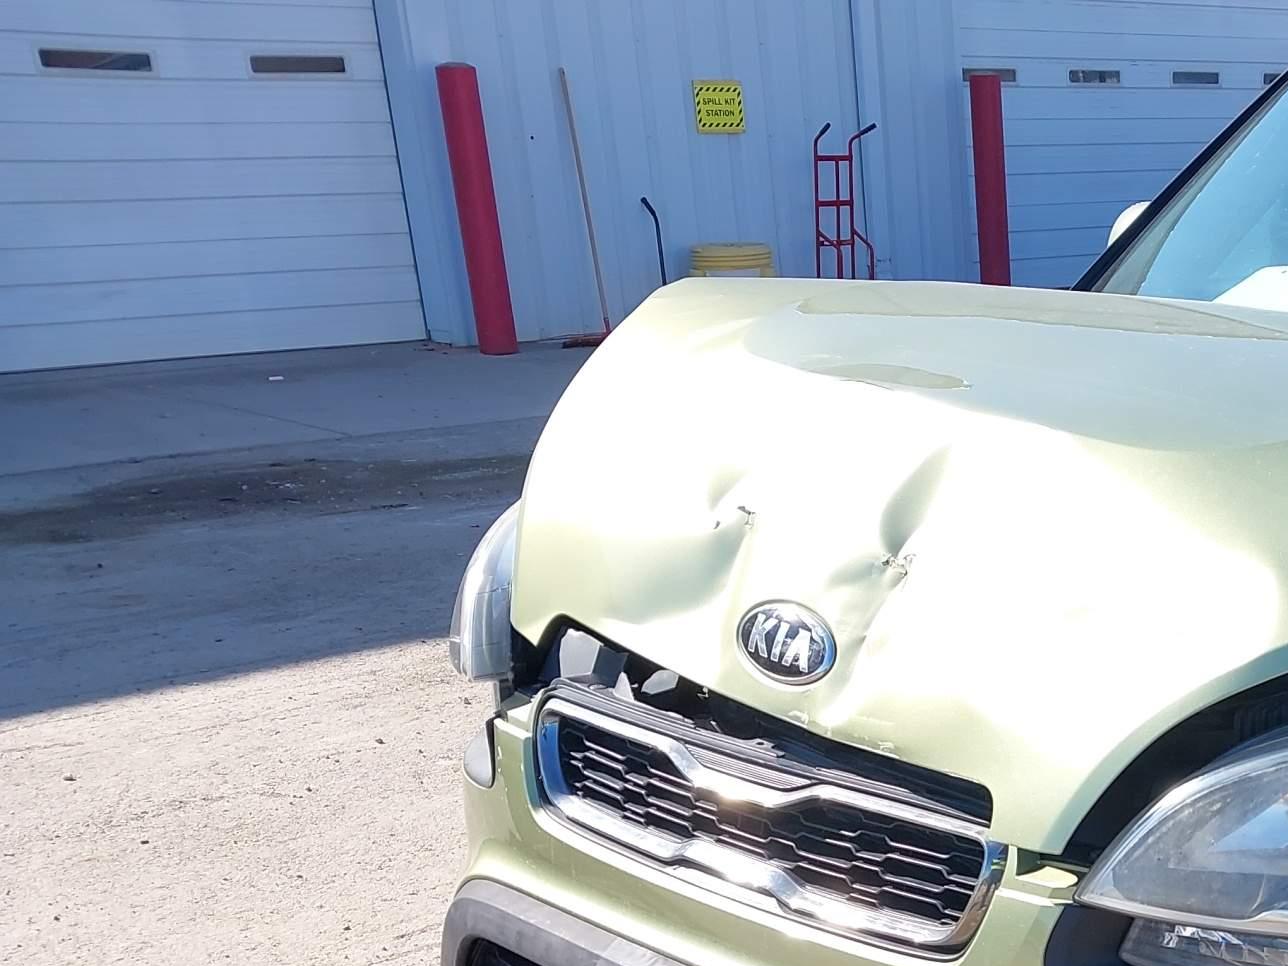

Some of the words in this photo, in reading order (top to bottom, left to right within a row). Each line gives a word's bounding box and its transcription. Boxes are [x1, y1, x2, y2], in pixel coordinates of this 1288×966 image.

[702, 97, 722, 106] SPILL
[724, 97, 736, 106] KIT
[705, 109, 735, 117] STATION
[747, 612, 812, 673] KIA
